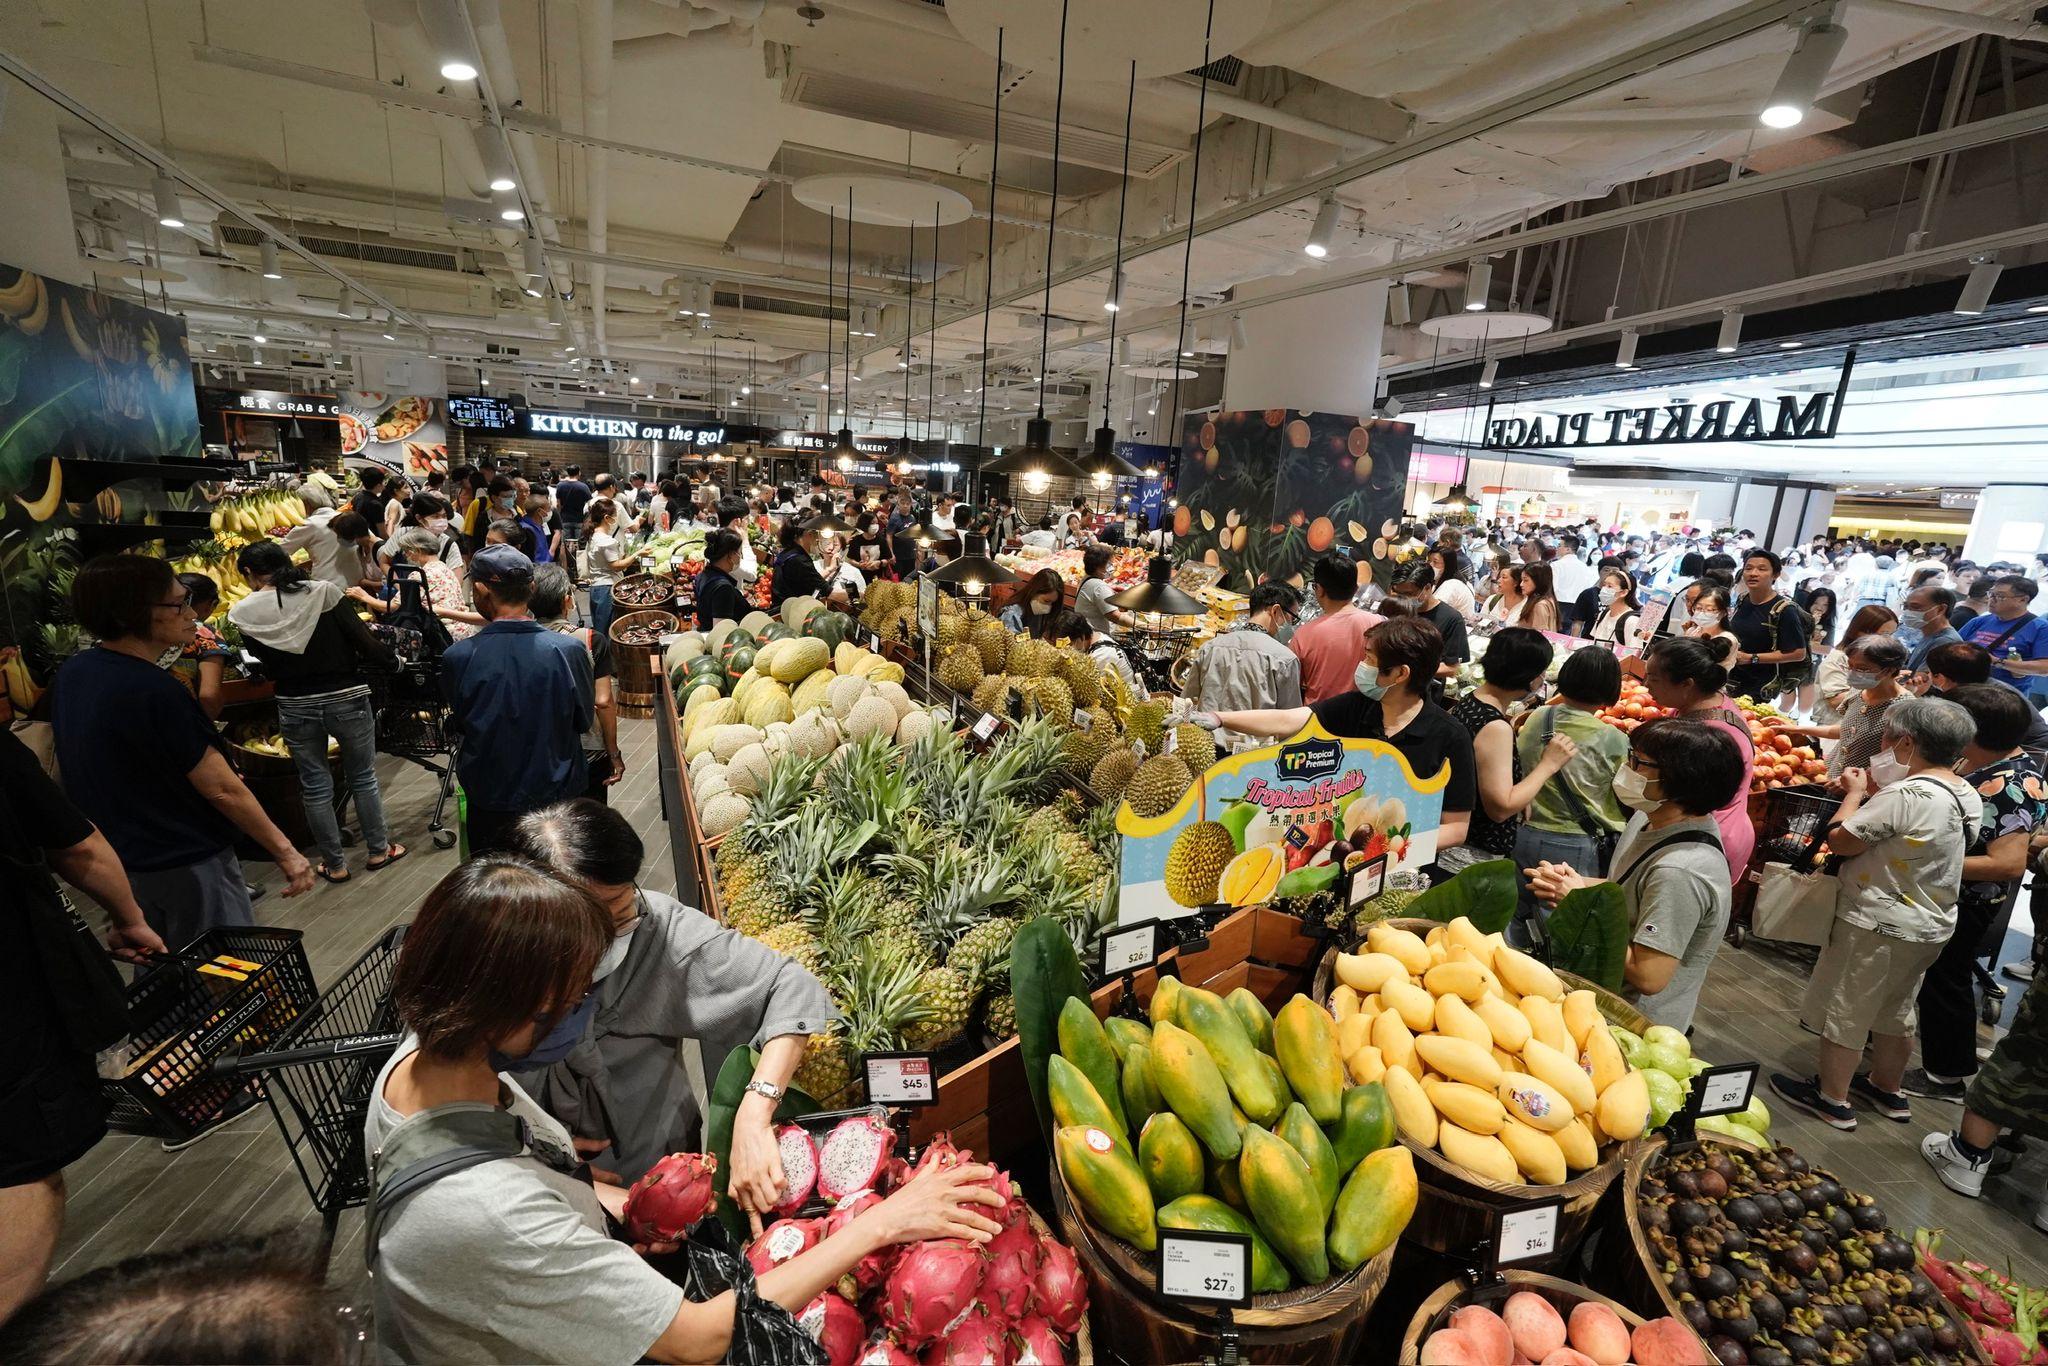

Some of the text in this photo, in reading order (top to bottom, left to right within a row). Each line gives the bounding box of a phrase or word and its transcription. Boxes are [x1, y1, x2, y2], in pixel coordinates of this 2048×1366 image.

[240, 396, 340, 414] 輕食 GRAB & G
[530, 414, 725, 445] KITCHEN on the go!
[856, 443, 888, 452] BAKERY
[388, 463, 403, 475] MADE
[1142, 488, 1161, 504] yuu
[1284, 752, 1307, 770] TP
[1307, 749, 1335, 761] Tropical
[1305, 759, 1335, 769] Premium
[1245, 768, 1367, 814] Tropical Fruits
[1269, 805, 1341, 827] 熱帶精選水果
[205, 999, 262, 1048] MARKET PLACE
[342, 1033, 394, 1046] MARKET
[1204, 1277, 1235, 1292] $27.0
